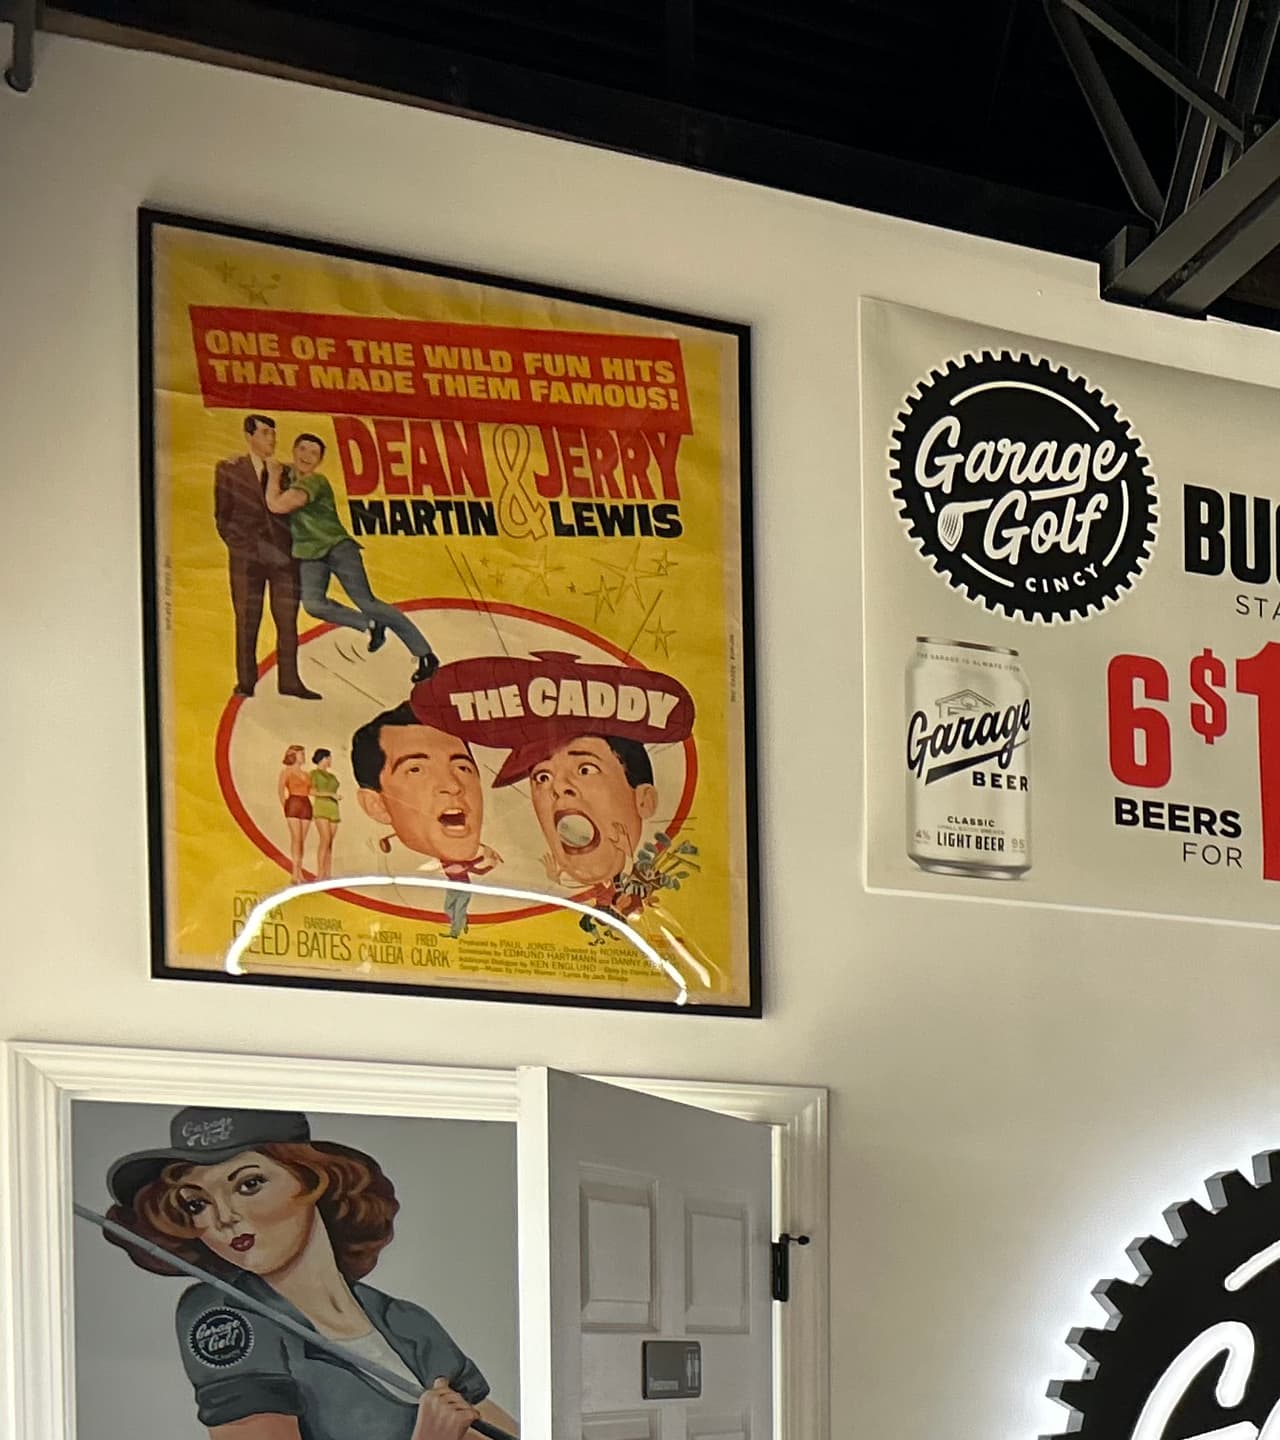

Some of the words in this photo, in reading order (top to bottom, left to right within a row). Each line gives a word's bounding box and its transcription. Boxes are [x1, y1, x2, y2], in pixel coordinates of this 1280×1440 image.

[205, 329, 280, 358] ONE
[292, 337, 335, 362] OF
[346, 339, 414, 365] THE
[425, 344, 513, 374] WILD
[525, 352, 591, 379] FUN
[602, 357, 676, 385] HITS
[209, 359, 299, 387] THAT
[311, 365, 415, 395] MADE
[425, 372, 520, 400] THEM
[533, 381, 680, 411] FAMOUS!
[333, 414, 491, 498] DEAN
[534, 424, 682, 500] JERRY
[914, 416, 1128, 494] Garage
[350, 499, 498, 536] MARTIN
[549, 503, 683, 538] LEWIS
[983, 489, 1109, 566] Golf
[1025, 563, 1099, 593] CINCY
[450, 684, 525, 721] THE
[528, 677, 679, 729] CADDY
[1107, 653, 1171, 789] 6
[907, 699, 1031, 779] Garage
[972, 771, 1029, 792] BEER
[937, 832, 972, 849] LIGHT
[975, 834, 1005, 852] BEER
[947, 815, 996, 828] CLASSIC
[1114, 797, 1242, 840] BEERS
[1182, 842, 1243, 870] FOR
[297, 930, 351, 961] BATES
